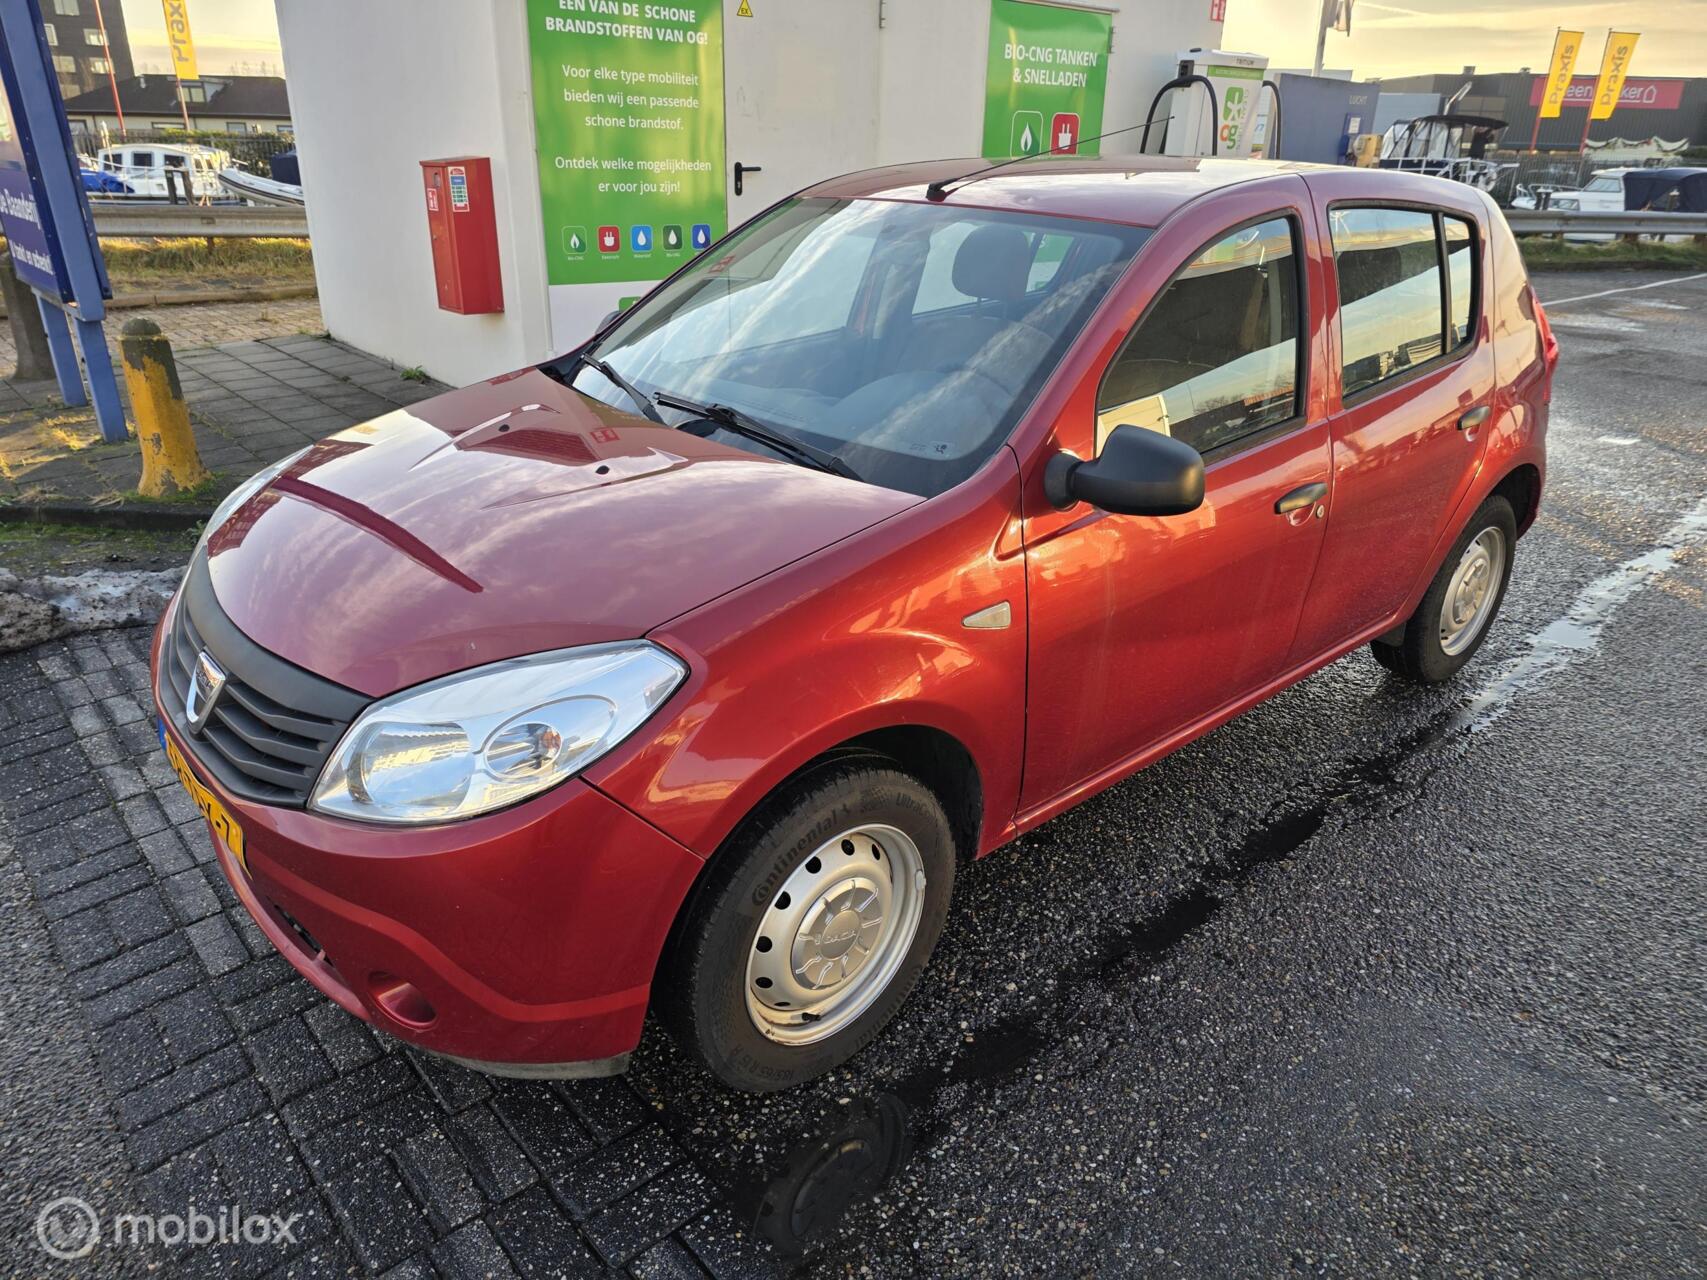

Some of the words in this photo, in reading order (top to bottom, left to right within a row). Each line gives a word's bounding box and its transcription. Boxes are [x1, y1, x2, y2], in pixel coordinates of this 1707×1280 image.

[589, 0, 619, 16] VAN
[623, 3, 639, 17] DE
[644, 5, 696, 23] SCHONE
[545, 16, 653, 40] BRANDSTOFFEN
[656, 28, 683, 43] VAN
[687, 31, 708, 45] OG!
[1004, 43, 1053, 63] BIO-CNG
[1055, 48, 1097, 67] TANKEN
[562, 64, 590, 79] Voor
[594, 67, 618, 80] elke
[621, 69, 645, 85] type
[648, 71, 698, 86] mobiliteit
[1013, 68, 1022, 82] &
[1024, 69, 1087, 88] SNELLADEN
[1550, 44, 1574, 105] Praxis
[1600, 45, 1628, 106] Praxis
[564, 89, 604, 103] bieden
[607, 91, 624, 108] wij
[627, 94, 646, 106] een
[650, 95, 699, 109] passende
[585, 114, 625, 128] schone
[629, 116, 684, 130] brandstof.
[555, 156, 599, 170] Ontdek
[602, 158, 634, 170] welke
[637, 159, 711, 174] mogelijkheden
[598, 182, 609, 192] er
[613, 182, 637, 192] voor
[640, 181, 657, 195] jou
[659, 181, 680, 195] zijn!
[751, 808, 837, 906] Continental
